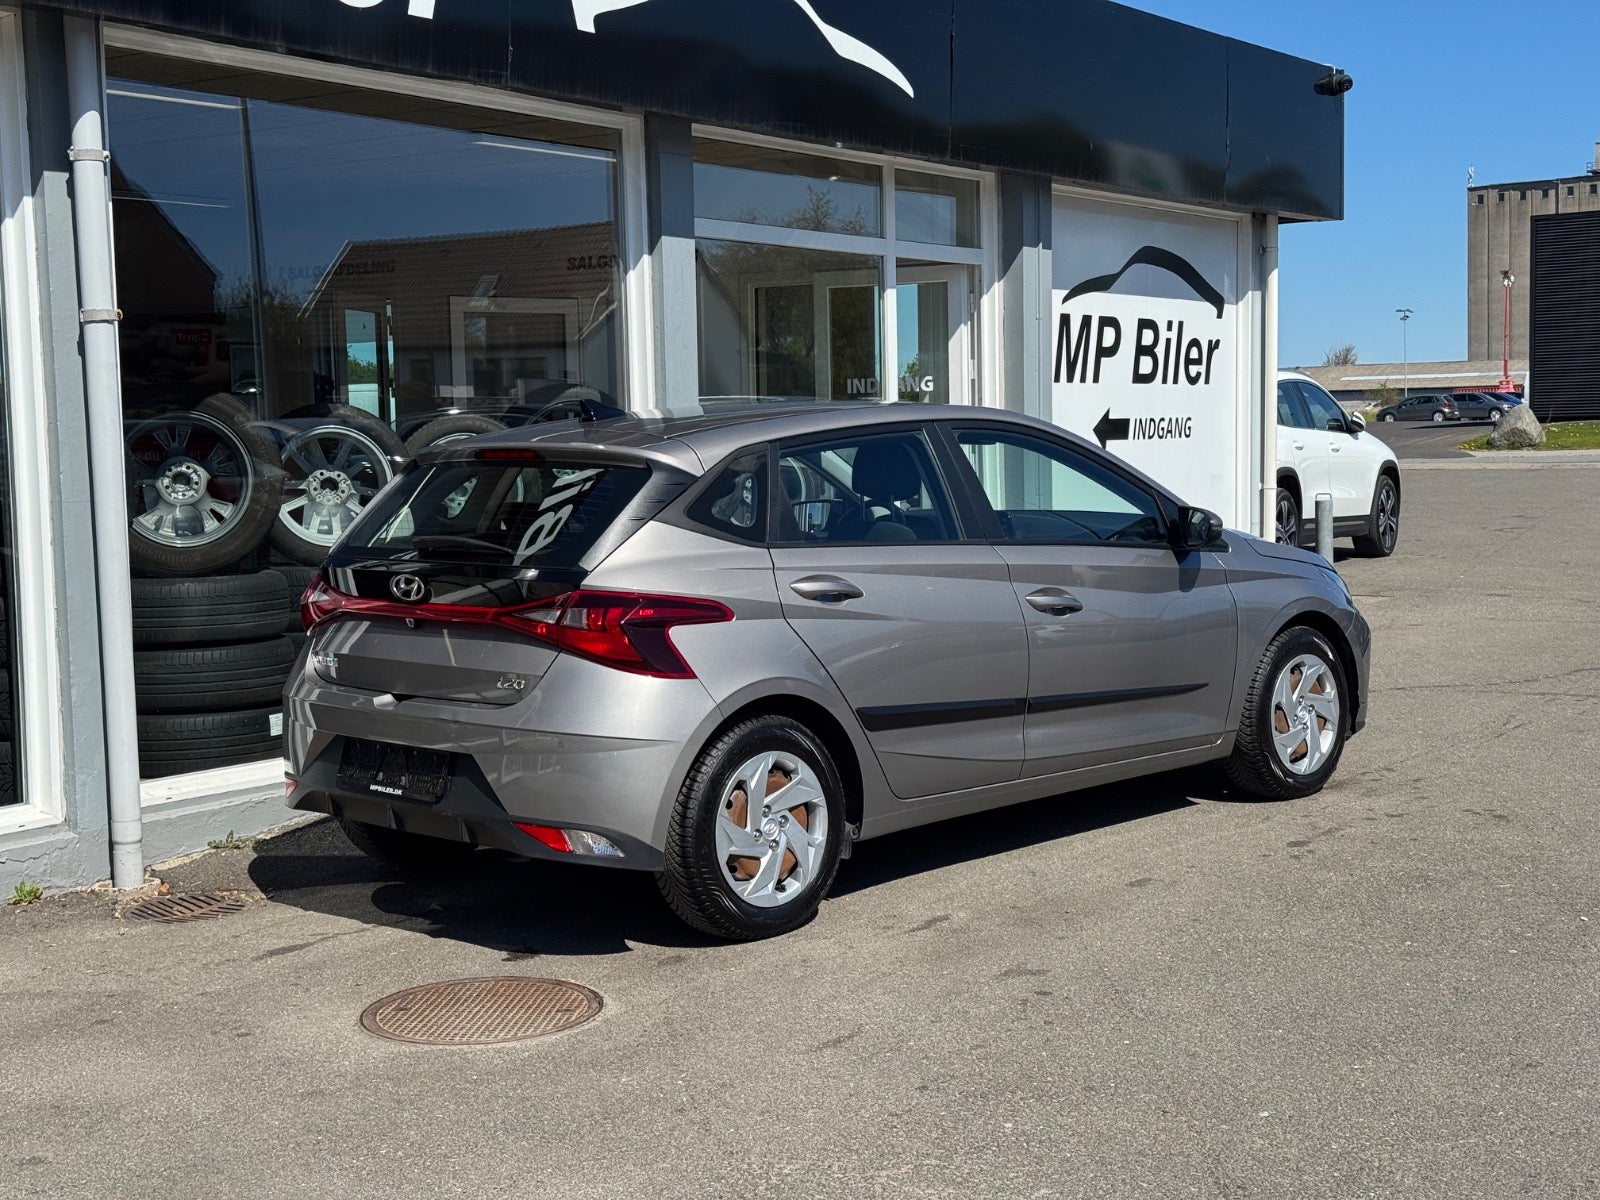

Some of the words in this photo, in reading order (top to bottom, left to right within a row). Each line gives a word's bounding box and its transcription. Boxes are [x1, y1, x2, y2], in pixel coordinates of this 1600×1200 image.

[1053, 313, 1121, 384] MP
[1132, 318, 1222, 386] Biler
[846, 375, 934, 394] INDANG
[1132, 416, 1192, 441] INDGANG
